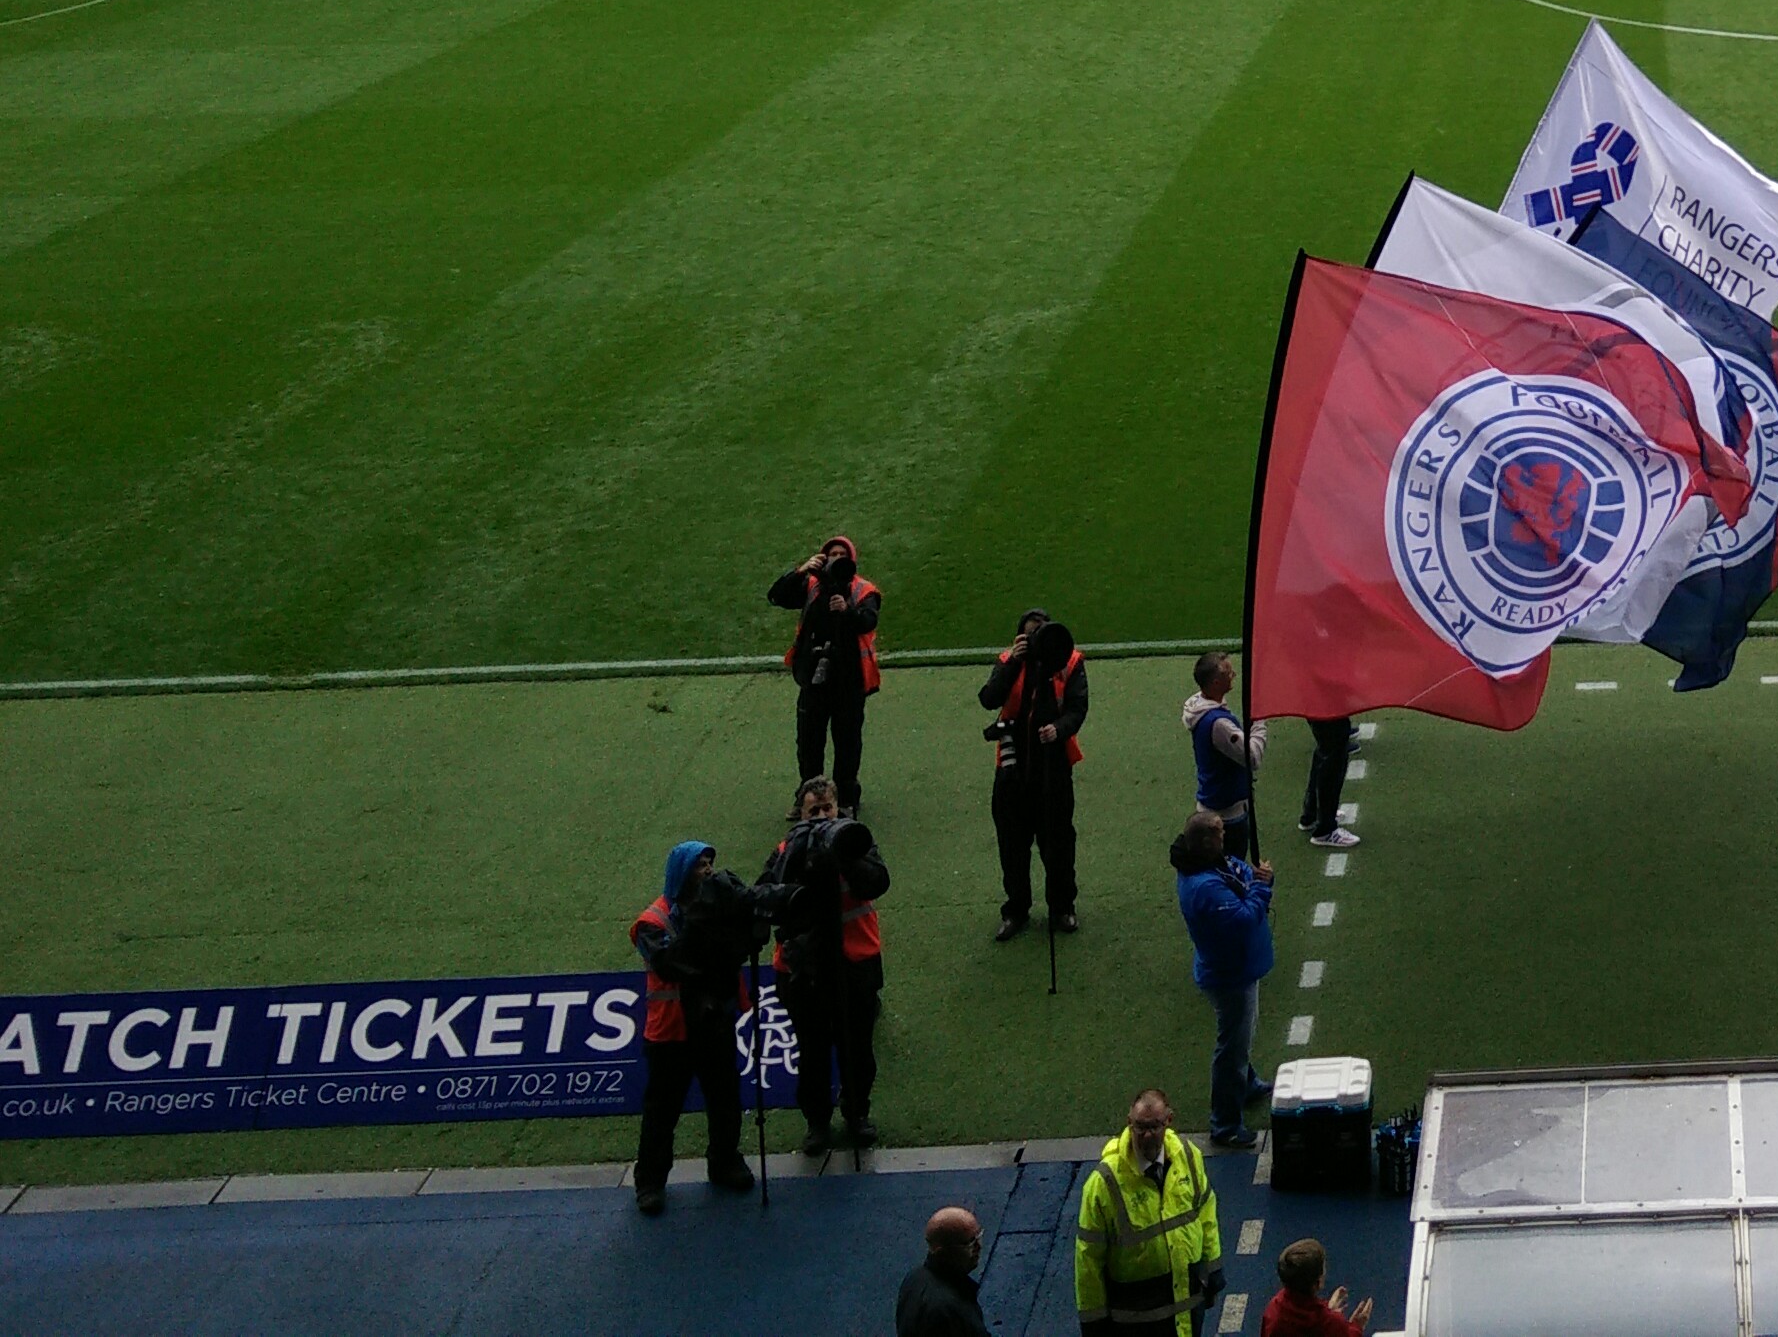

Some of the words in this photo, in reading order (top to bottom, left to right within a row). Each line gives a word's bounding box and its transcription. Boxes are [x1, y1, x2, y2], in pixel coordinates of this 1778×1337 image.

[1658, 225, 1765, 307] CHARITY
[1406, 423, 1475, 640] RANGERS
[1490, 596, 1569, 625] READY
[0, 1006, 235, 1075] ATCH
[266, 989, 638, 1065] TICKETS
[104, 1090, 216, 1115] Rangers
[225, 1083, 309, 1108] Ticket
[317, 1081, 407, 1104] Centre
[436, 1075, 499, 1099] 0871
[507, 1072, 558, 1096] 702
[566, 1069, 624, 1093] 1972
[511, 1098, 541, 1108] minute
